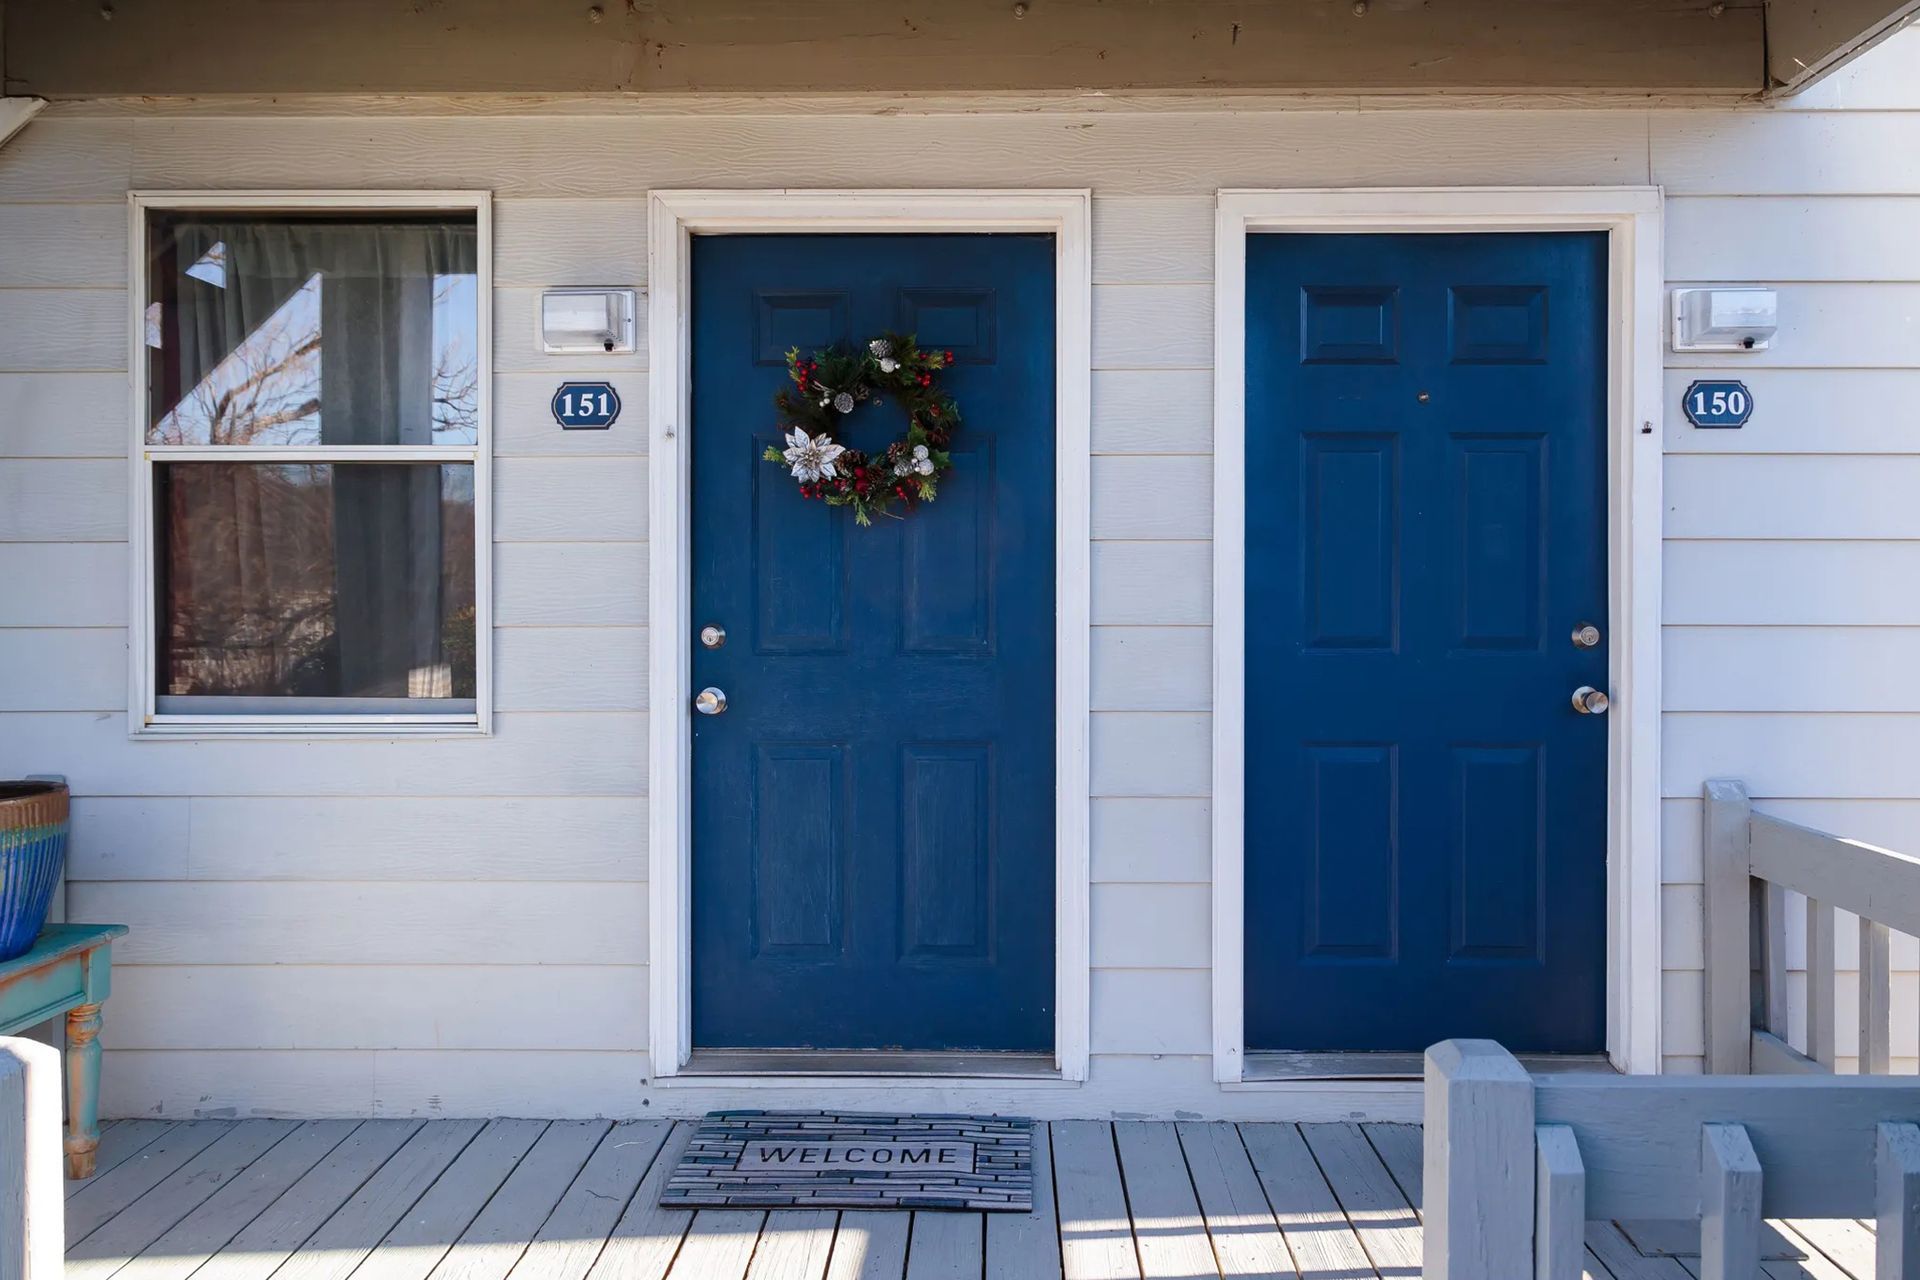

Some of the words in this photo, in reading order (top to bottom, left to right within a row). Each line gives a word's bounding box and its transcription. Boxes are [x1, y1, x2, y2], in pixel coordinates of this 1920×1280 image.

[562, 393, 610, 416] 151
[1694, 391, 1745, 415] 150
[760, 1147, 957, 1164] WELCOME
